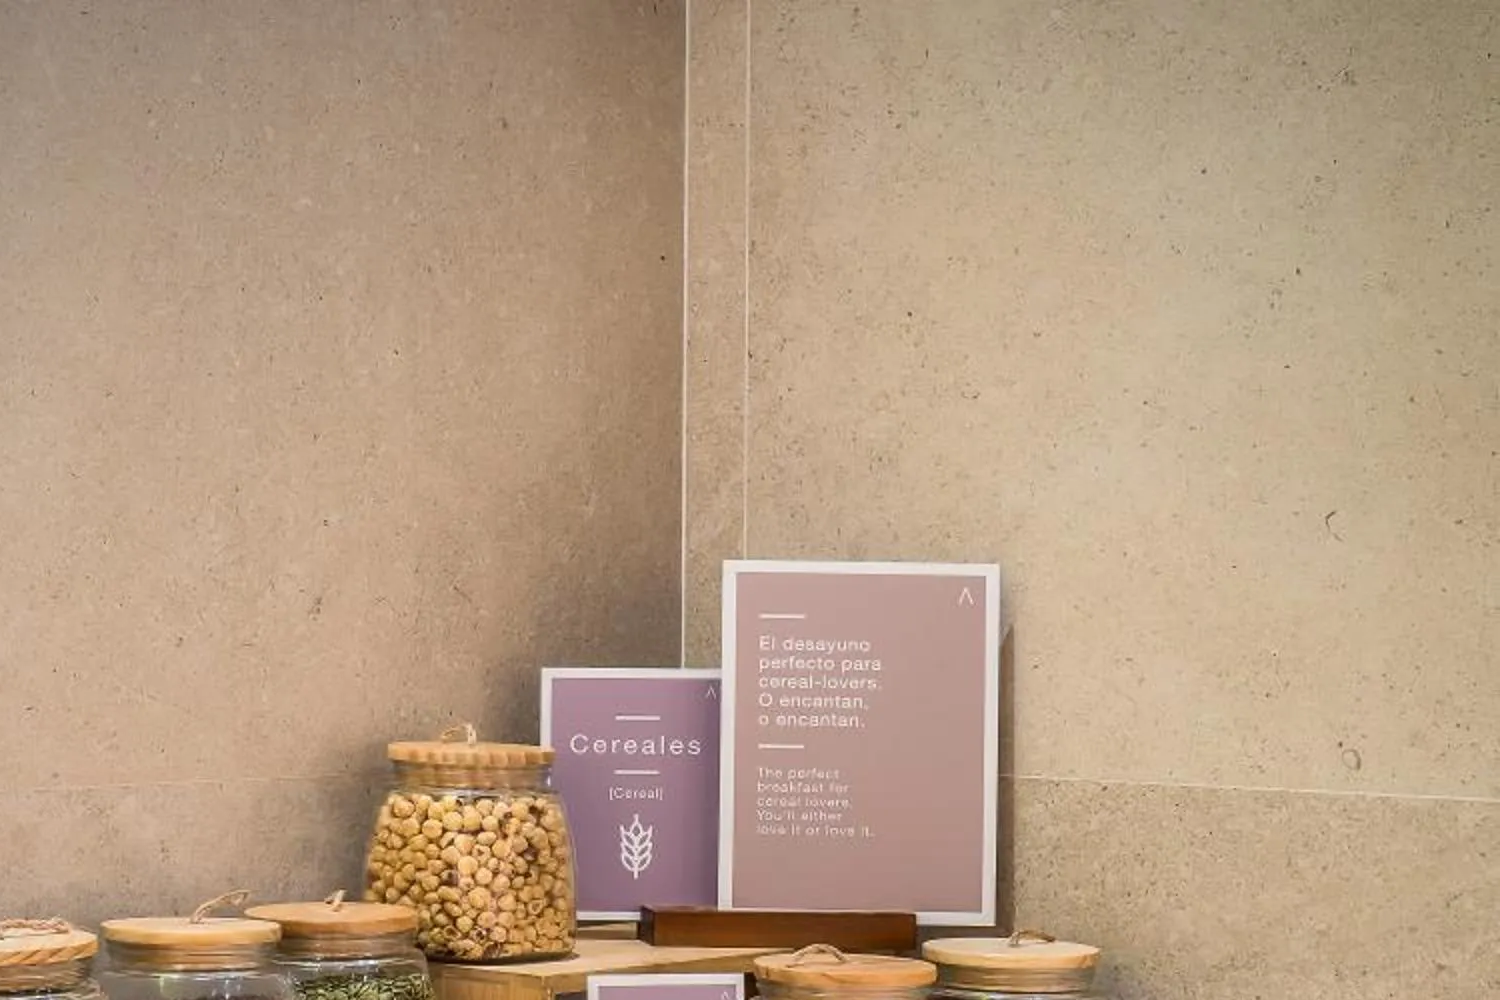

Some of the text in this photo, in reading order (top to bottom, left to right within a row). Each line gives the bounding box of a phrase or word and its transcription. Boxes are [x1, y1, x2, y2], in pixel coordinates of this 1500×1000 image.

[759, 635, 871, 655] El desayuno
[759, 656, 881, 674] perfecto para
[759, 692, 773, 707] O
[759, 714, 769, 726] o
[570, 734, 701, 755] Cereales
[758, 767, 840, 781] The perfect
[757, 780, 823, 793] breakfast
